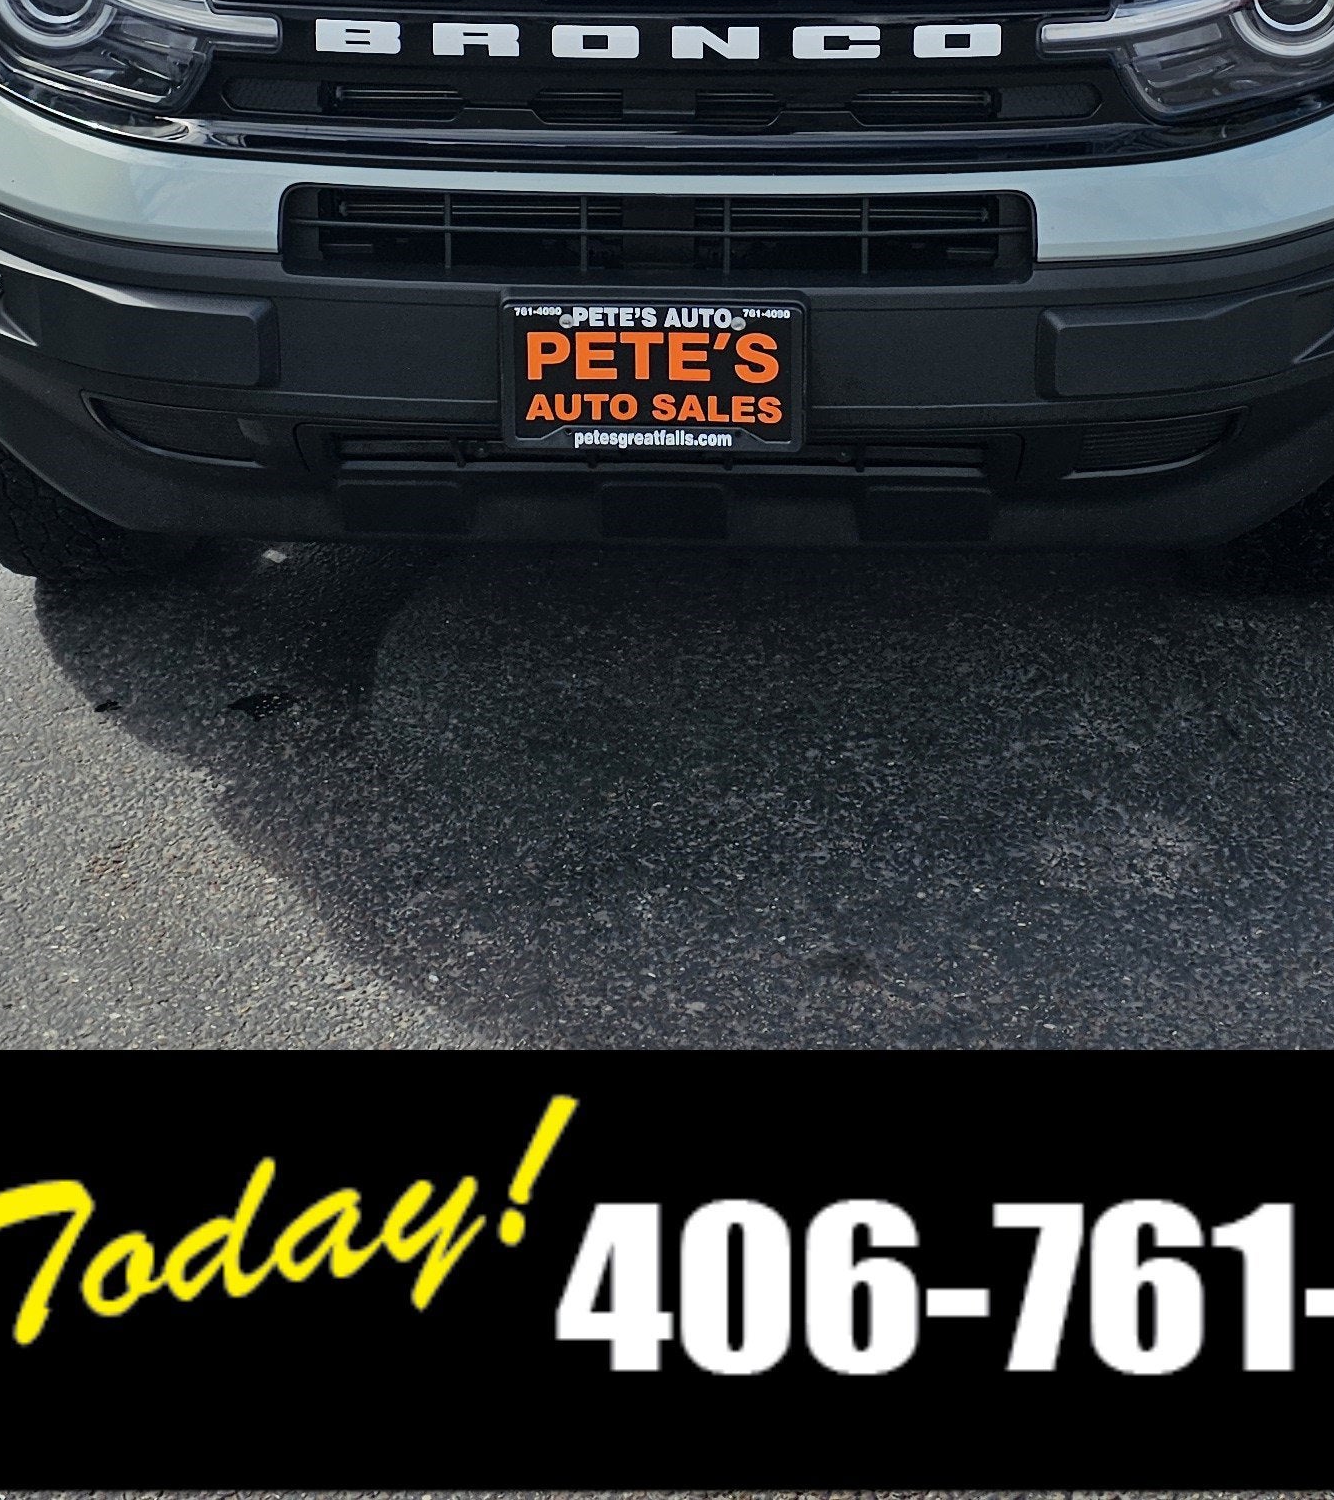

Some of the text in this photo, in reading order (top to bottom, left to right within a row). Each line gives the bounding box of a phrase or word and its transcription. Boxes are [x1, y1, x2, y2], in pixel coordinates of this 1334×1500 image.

[315, 18, 1002, 60] BRONCO
[573, 307, 732, 328] PETE'S AUTO
[526, 331, 779, 384] PETE'S
[526, 394, 782, 424] AUTO SALES
[574, 429, 733, 448] petesgreatfalls.com
